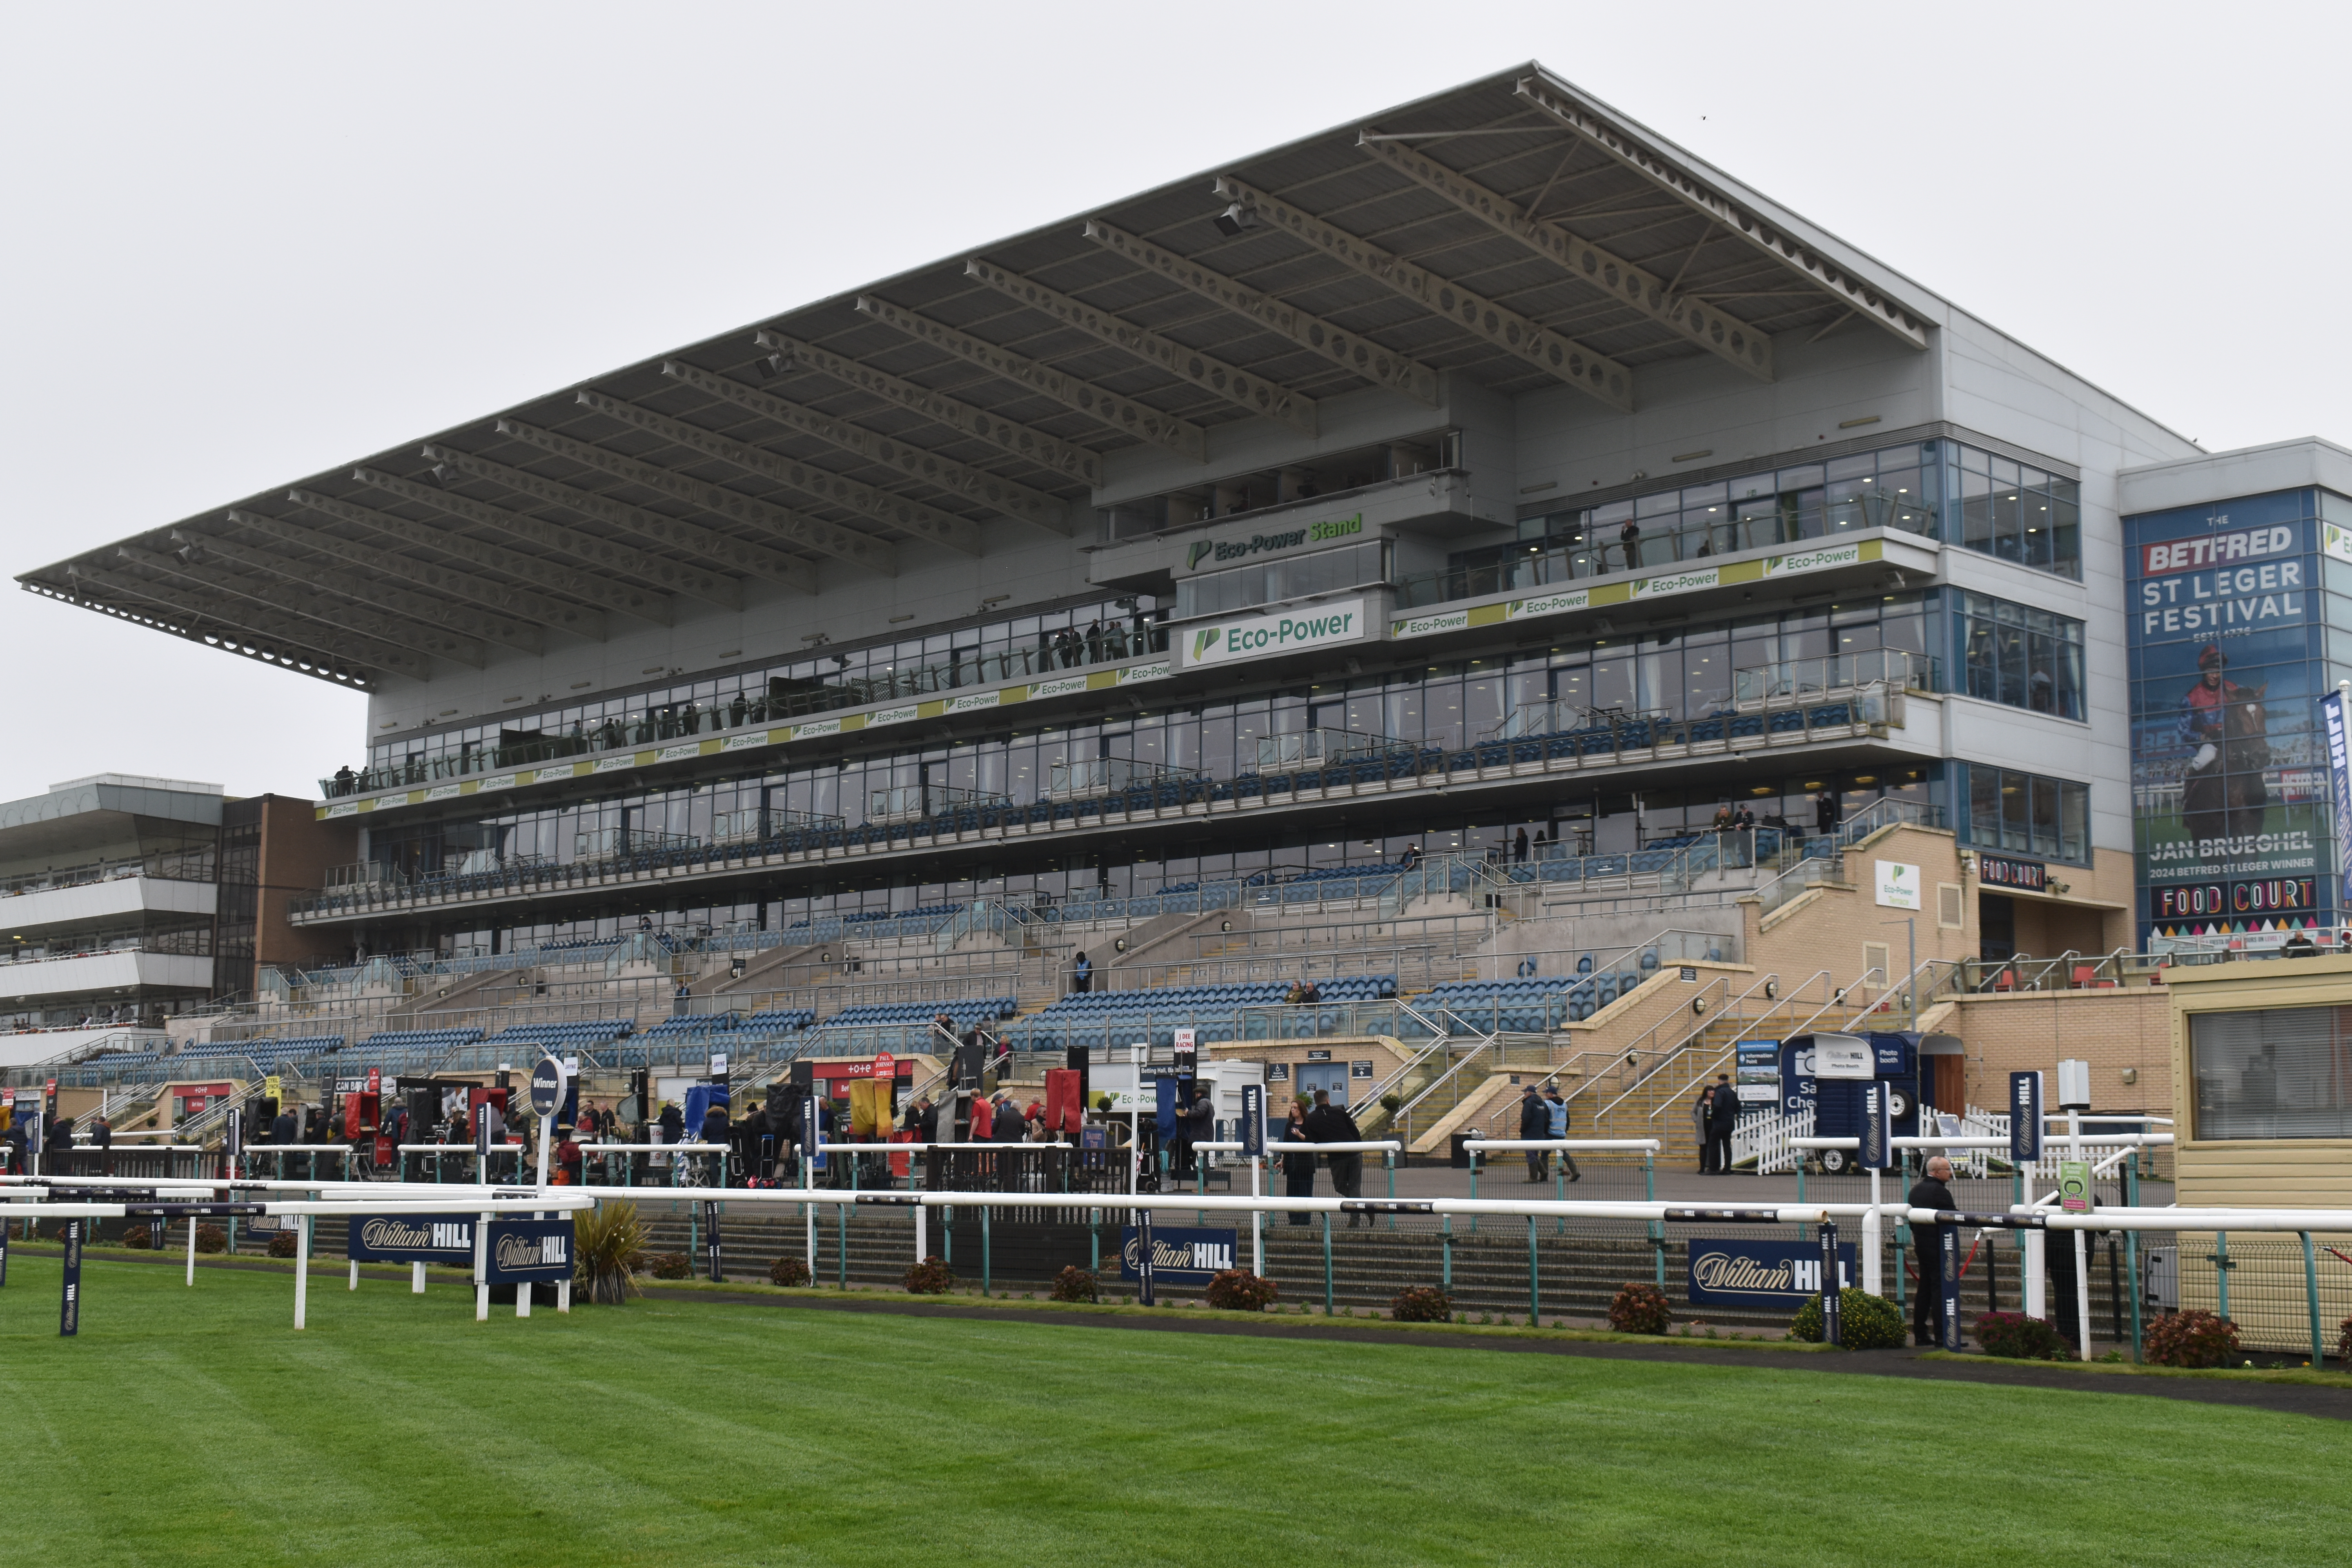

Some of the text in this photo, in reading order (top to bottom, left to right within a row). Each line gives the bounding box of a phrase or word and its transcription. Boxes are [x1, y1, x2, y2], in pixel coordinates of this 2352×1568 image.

[2207, 515, 2229, 526] THE
[1215, 513, 1362, 561] Eco-Power Stand
[2149, 526, 2292, 571] BETFRED
[1787, 549, 1857, 570] Eco-Power
[1653, 573, 1717, 592] Eco-Power
[2143, 562, 2301, 606] ST LEGER
[1527, 594, 1587, 613] Eco-Power
[2145, 593, 2301, 634] FESTIVAL
[1228, 613, 1352, 652] Eco-Power
[1411, 615, 1466, 633] Eco-Power
[1042, 679, 1086, 695] Eco-Power
[957, 695, 998, 709] Eco-Power
[878, 708, 916, 722] Eco-Power
[803, 722, 839, 735] Eco-Power
[733, 735, 767, 747] Eco-Power
[666, 746, 699, 758] Eco-Power
[603, 757, 634, 769] Eco-Power
[543, 766, 573, 779] Eco-Power
[487, 775, 515, 788] Eco-Power
[433, 786, 459, 798] Eco-Power
[333, 803, 358, 815] Eco-Power
[382, 796, 407, 807] Eco-Power
[2150, 831, 2314, 861] JAN BRUEGHEL
[1982, 858, 2043, 887] FOOD COURT
[2150, 858, 2314, 878] 2024 BETFRED ST LEGER WINNER
[1884, 885, 1913, 896] Eco-Power
[2161, 879, 2312, 916] FOOD COURT
[1889, 896, 1909, 906] Terrace
[848, 1064, 871, 1073] tote
[336, 1082, 349, 1091] CAN
[534, 1077, 557, 1088] Winner
[1122, 1094, 1157, 1103] Ec-Pow
[1787, 1096, 1817, 1109] Che
[1866, 1087, 1879, 1161] William HILL
[2018, 1077, 2032, 1155] William HILL
[1249, 1111, 1258, 1151] William
[361, 1218, 470, 1250] William HILL
[1944, 1233, 1952, 1250] HILL
[496, 1234, 566, 1271] William HILL
[1194, 1243, 1232, 1269] HILL
[1693, 1252, 1850, 1292] William HIL
[67, 1284, 76, 1301] HILL
[1946, 1298, 1955, 1316] HILL
